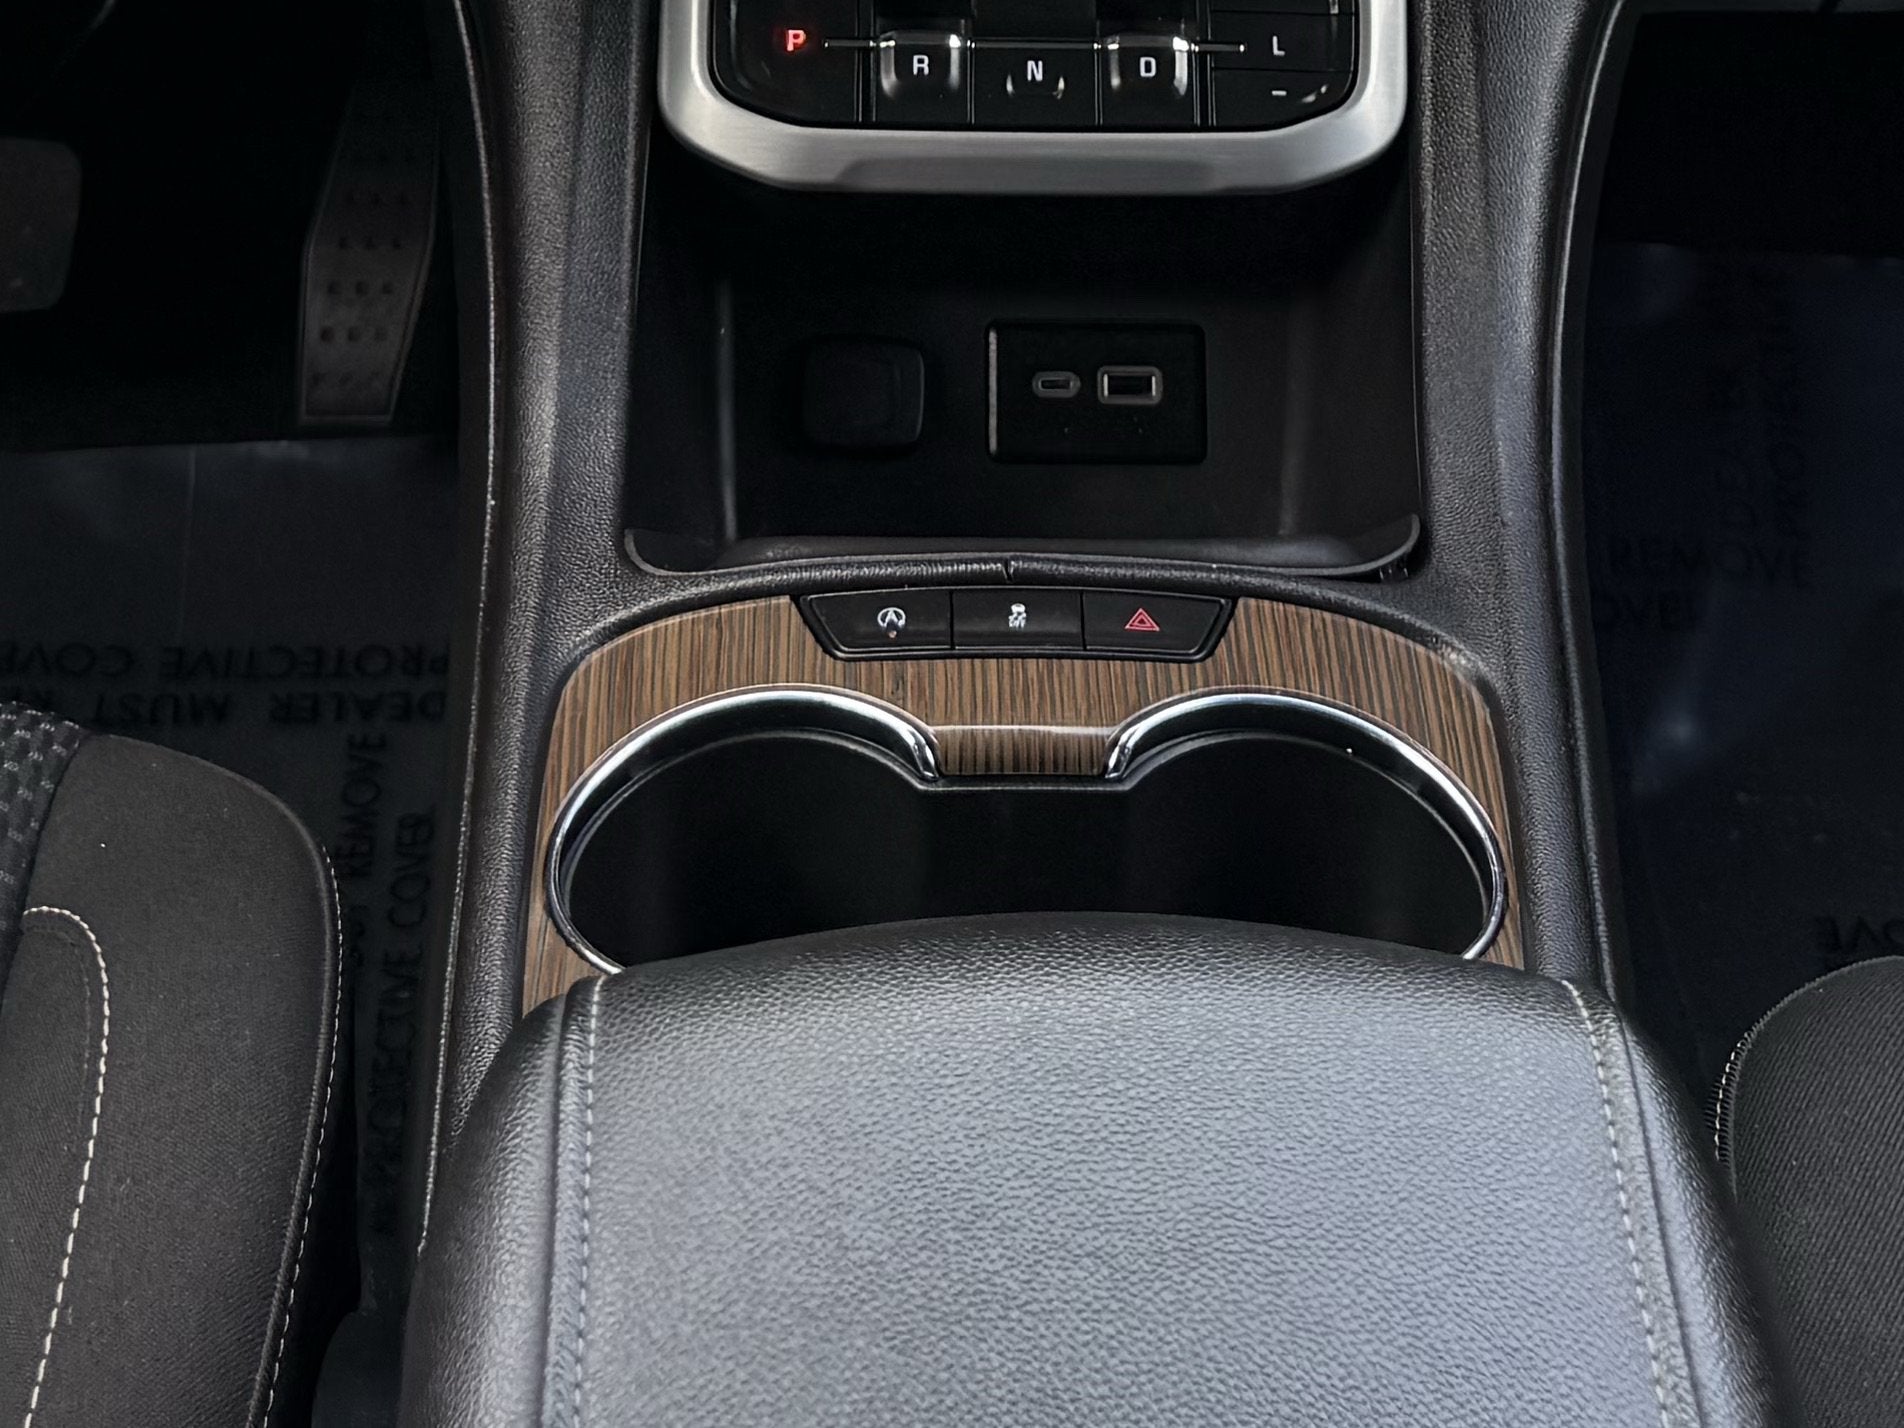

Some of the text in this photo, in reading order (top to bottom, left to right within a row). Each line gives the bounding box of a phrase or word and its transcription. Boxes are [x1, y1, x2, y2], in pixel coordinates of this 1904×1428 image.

[786, 28, 806, 52] P
[1272, 36, 1285, 57] L
[913, 54, 930, 76] R
[1027, 59, 1043, 81] N
[1140, 56, 1157, 78] D
